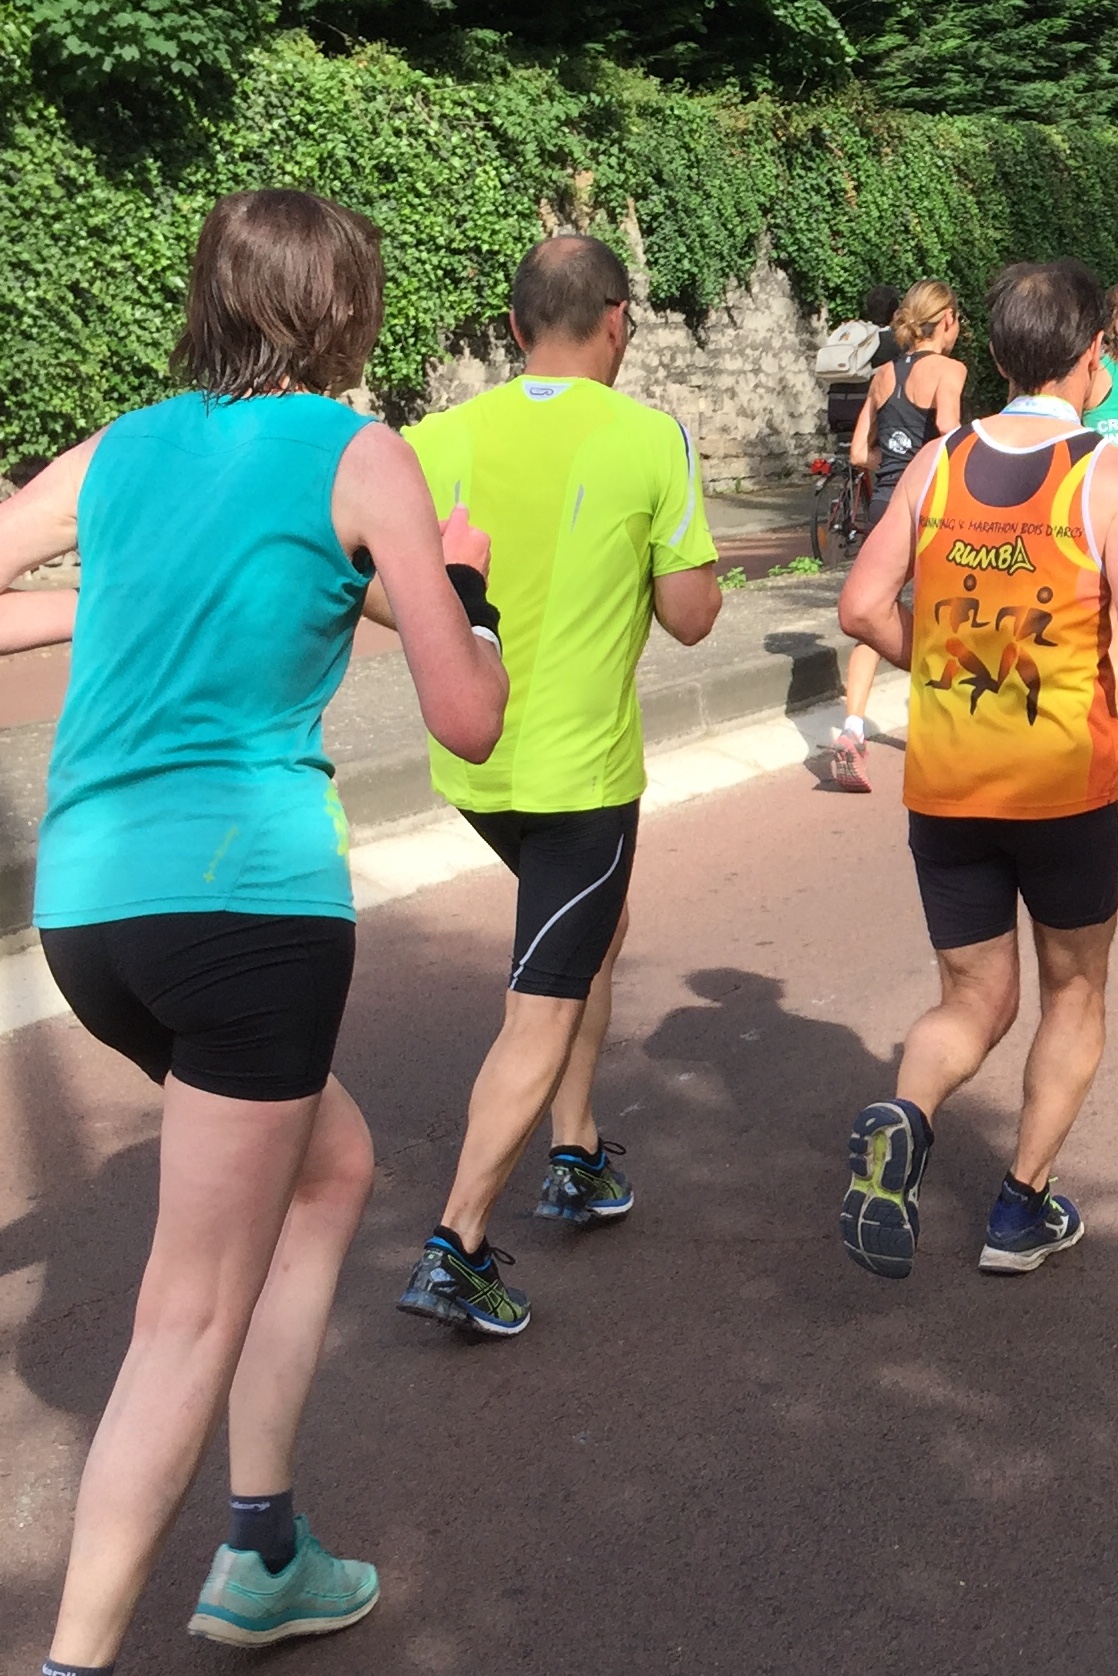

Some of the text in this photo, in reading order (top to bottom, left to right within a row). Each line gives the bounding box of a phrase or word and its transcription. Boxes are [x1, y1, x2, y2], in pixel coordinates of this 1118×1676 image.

[967, 520, 1018, 534] MARATHON
[1020, 522, 1043, 536] BOIS
[1045, 524, 1084, 539] D'ARCY
[946, 535, 1037, 576] RUMBA
